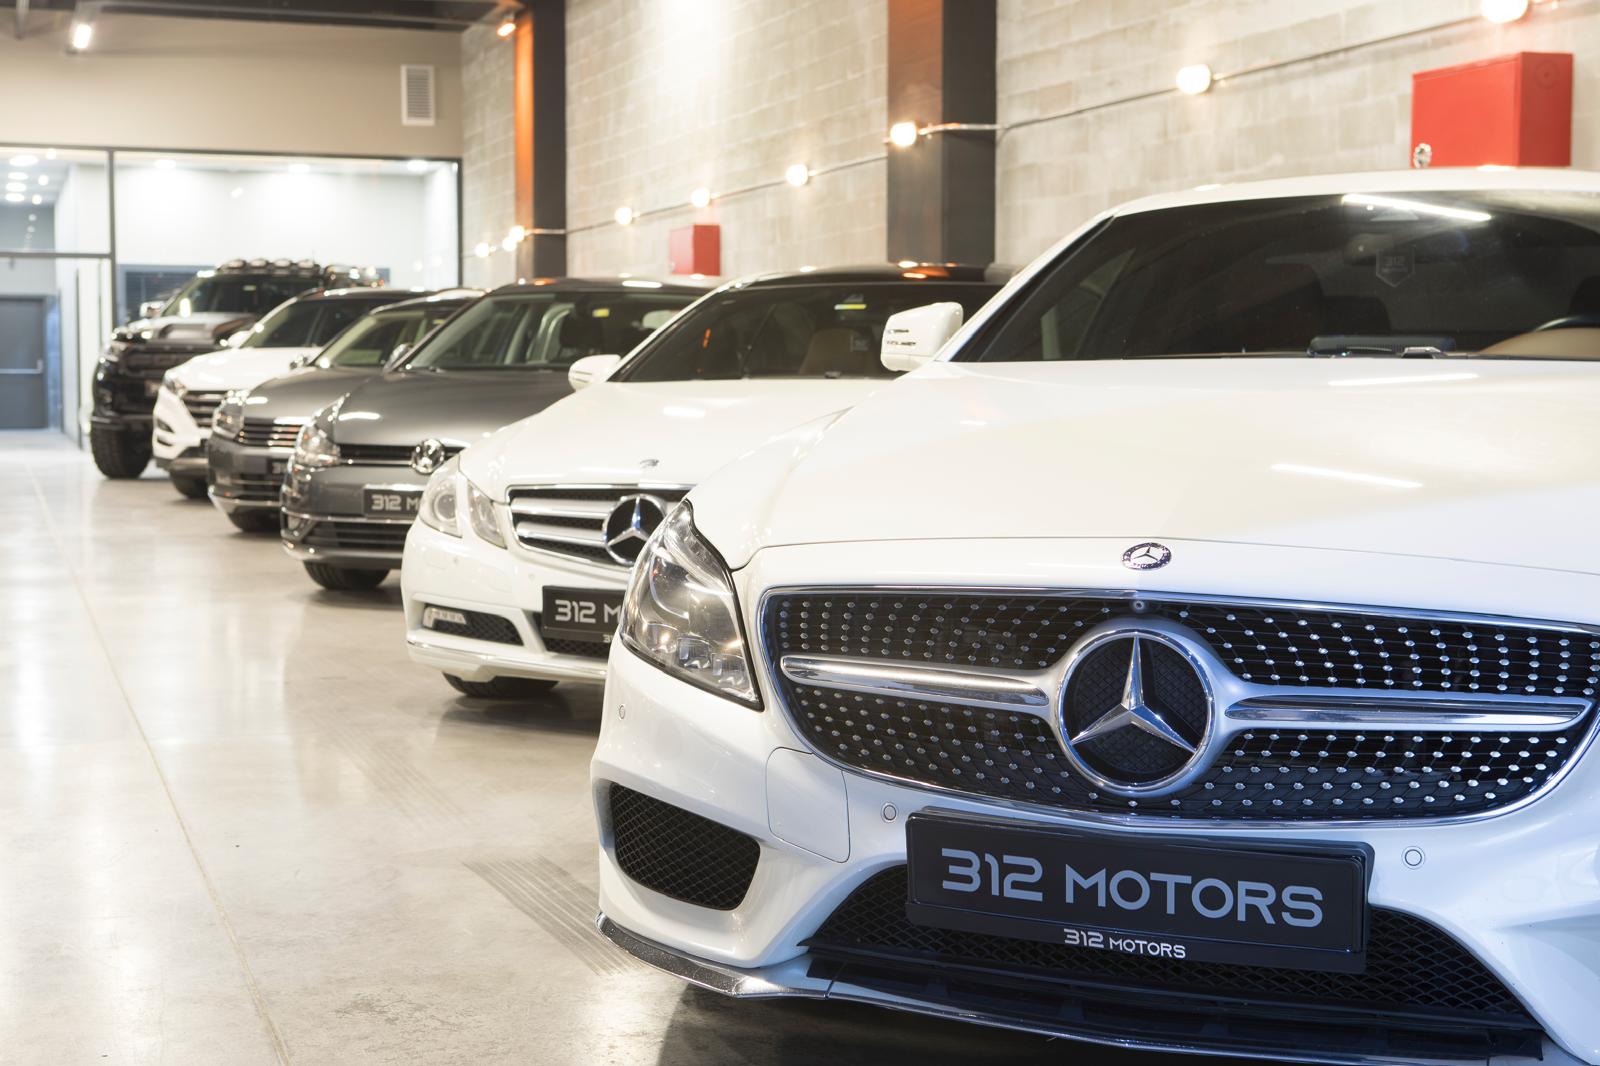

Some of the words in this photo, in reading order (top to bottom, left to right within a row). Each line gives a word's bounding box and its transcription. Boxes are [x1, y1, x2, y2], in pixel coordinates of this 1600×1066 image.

[371, 494, 401, 511] 312
[555, 599, 596, 623] 312
[941, 847, 1044, 902] 312
[1065, 863, 1324, 928] MOTORS
[1063, 928, 1104, 948] 312
[1109, 937, 1186, 959] MOTORS
